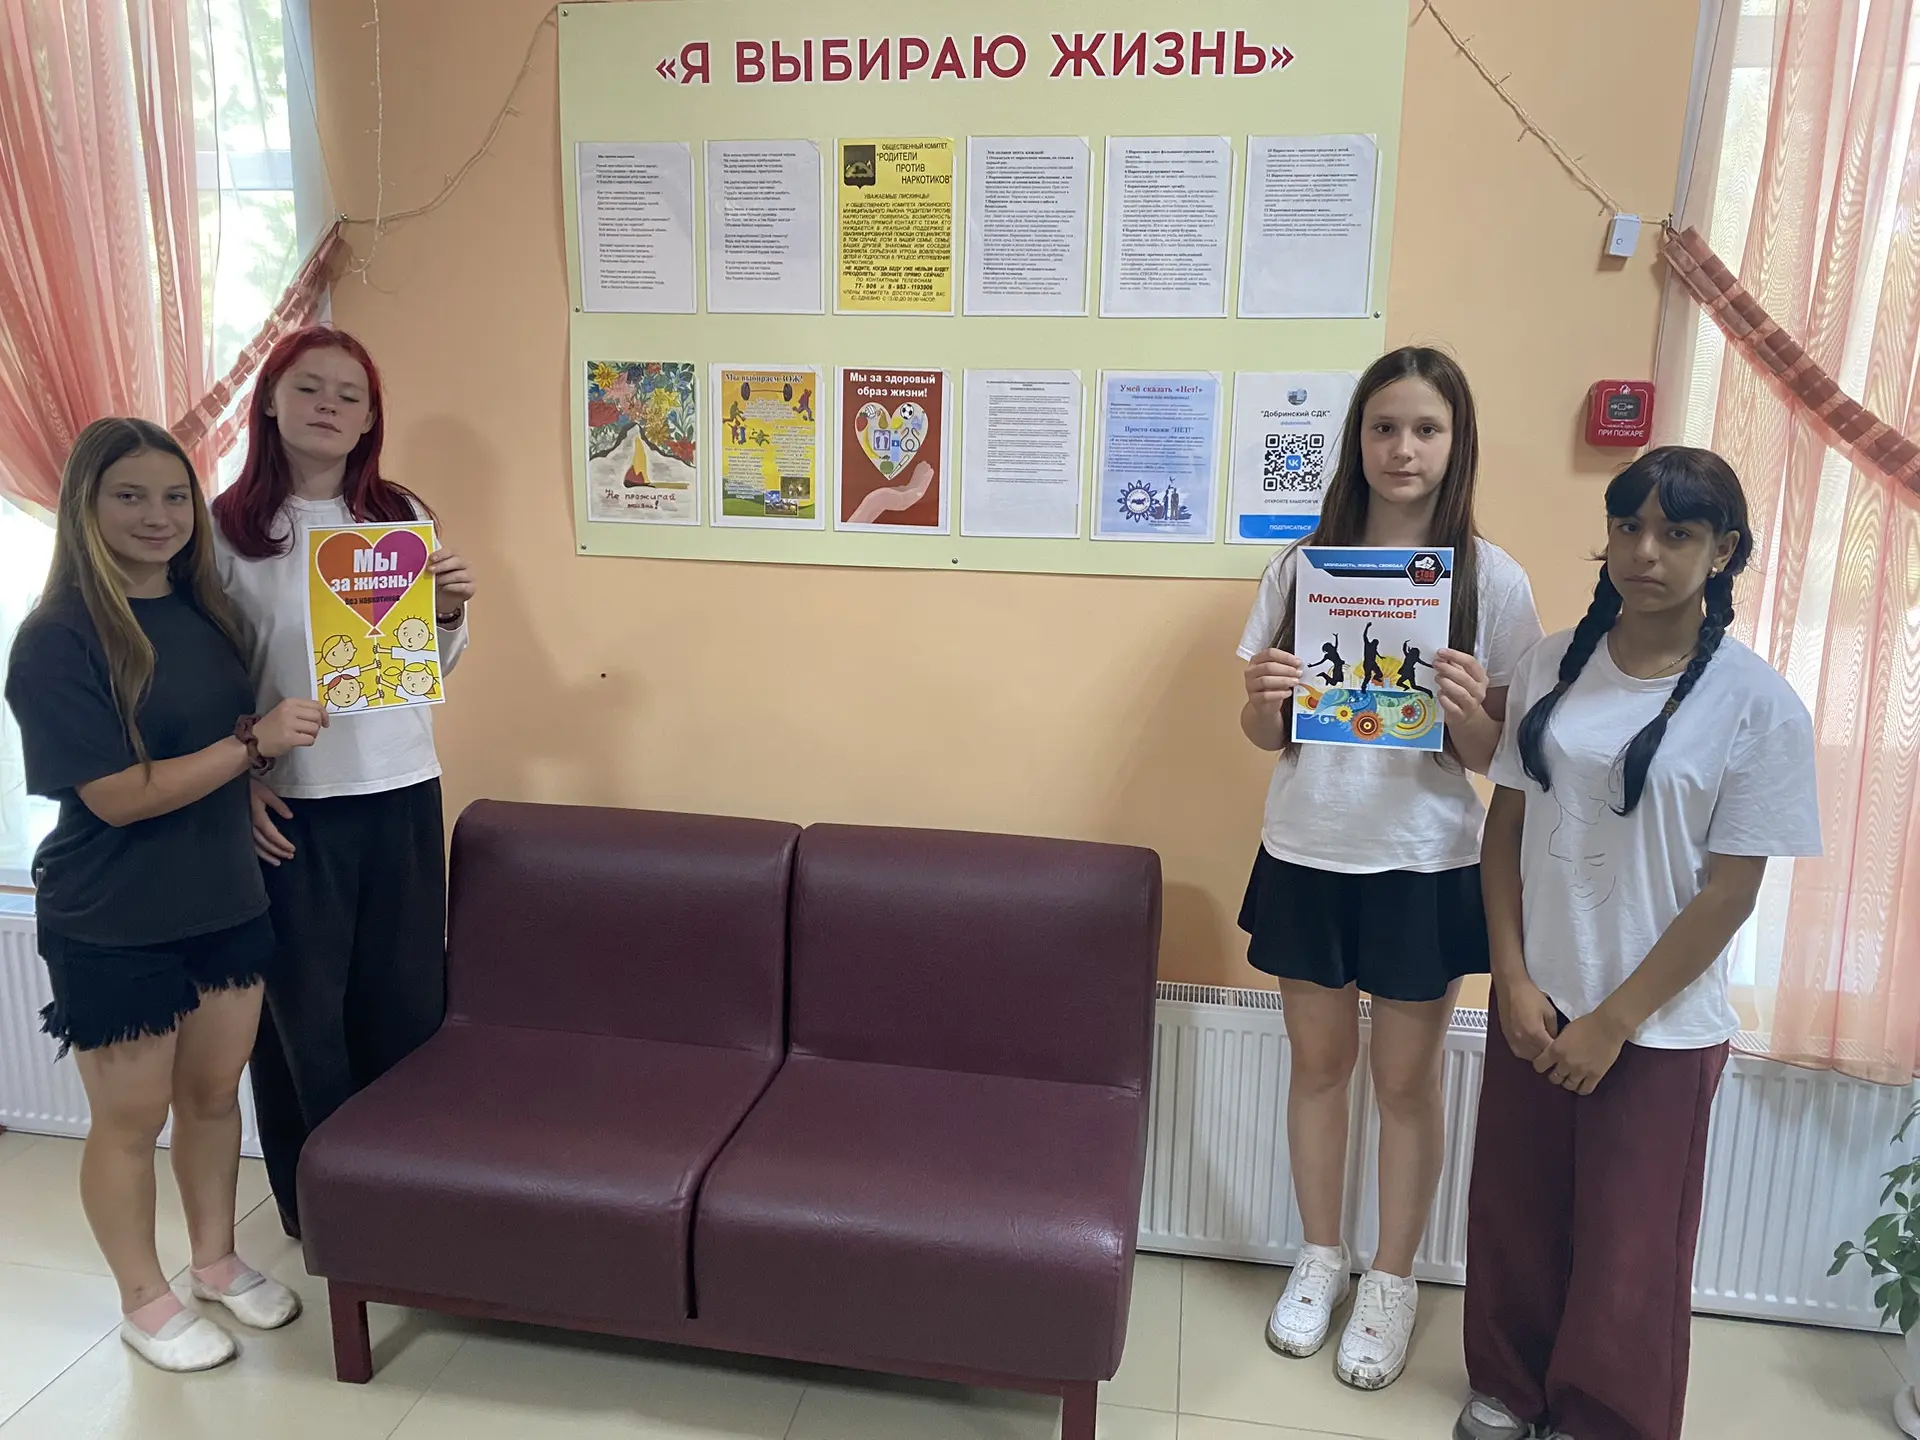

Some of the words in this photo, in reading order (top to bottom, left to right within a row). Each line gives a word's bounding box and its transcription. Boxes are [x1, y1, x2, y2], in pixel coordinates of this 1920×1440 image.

[655, 42, 709, 84] «Я
[736, 34, 1026, 83] ВЫБИРАЮ
[1050, 31, 1294, 77] ЖИЗНЬ»
[882, 142, 923, 150] ОБЩЕСТВЕННЫЙ
[896, 164, 925, 172] ПРОТИВ
[902, 175, 952, 184] НАРКОТИКОВ"
[850, 372, 867, 382] Мы
[885, 374, 936, 385] здоровый
[857, 386, 888, 397] образ
[890, 388, 928, 397] жизни!
[1120, 385, 1140, 393] Умей
[1261, 410, 1309, 418] "Добринский
[1124, 426, 1148, 434] Просто
[353, 548, 398, 573] Мы
[1415, 570, 1435, 578] СТОП
[331, 578, 350, 592] за
[354, 572, 413, 591] жизнь!
[1309, 593, 1384, 606] Молодежь
[1388, 598, 1439, 608] против
[1329, 607, 1417, 619] наркотиков!
